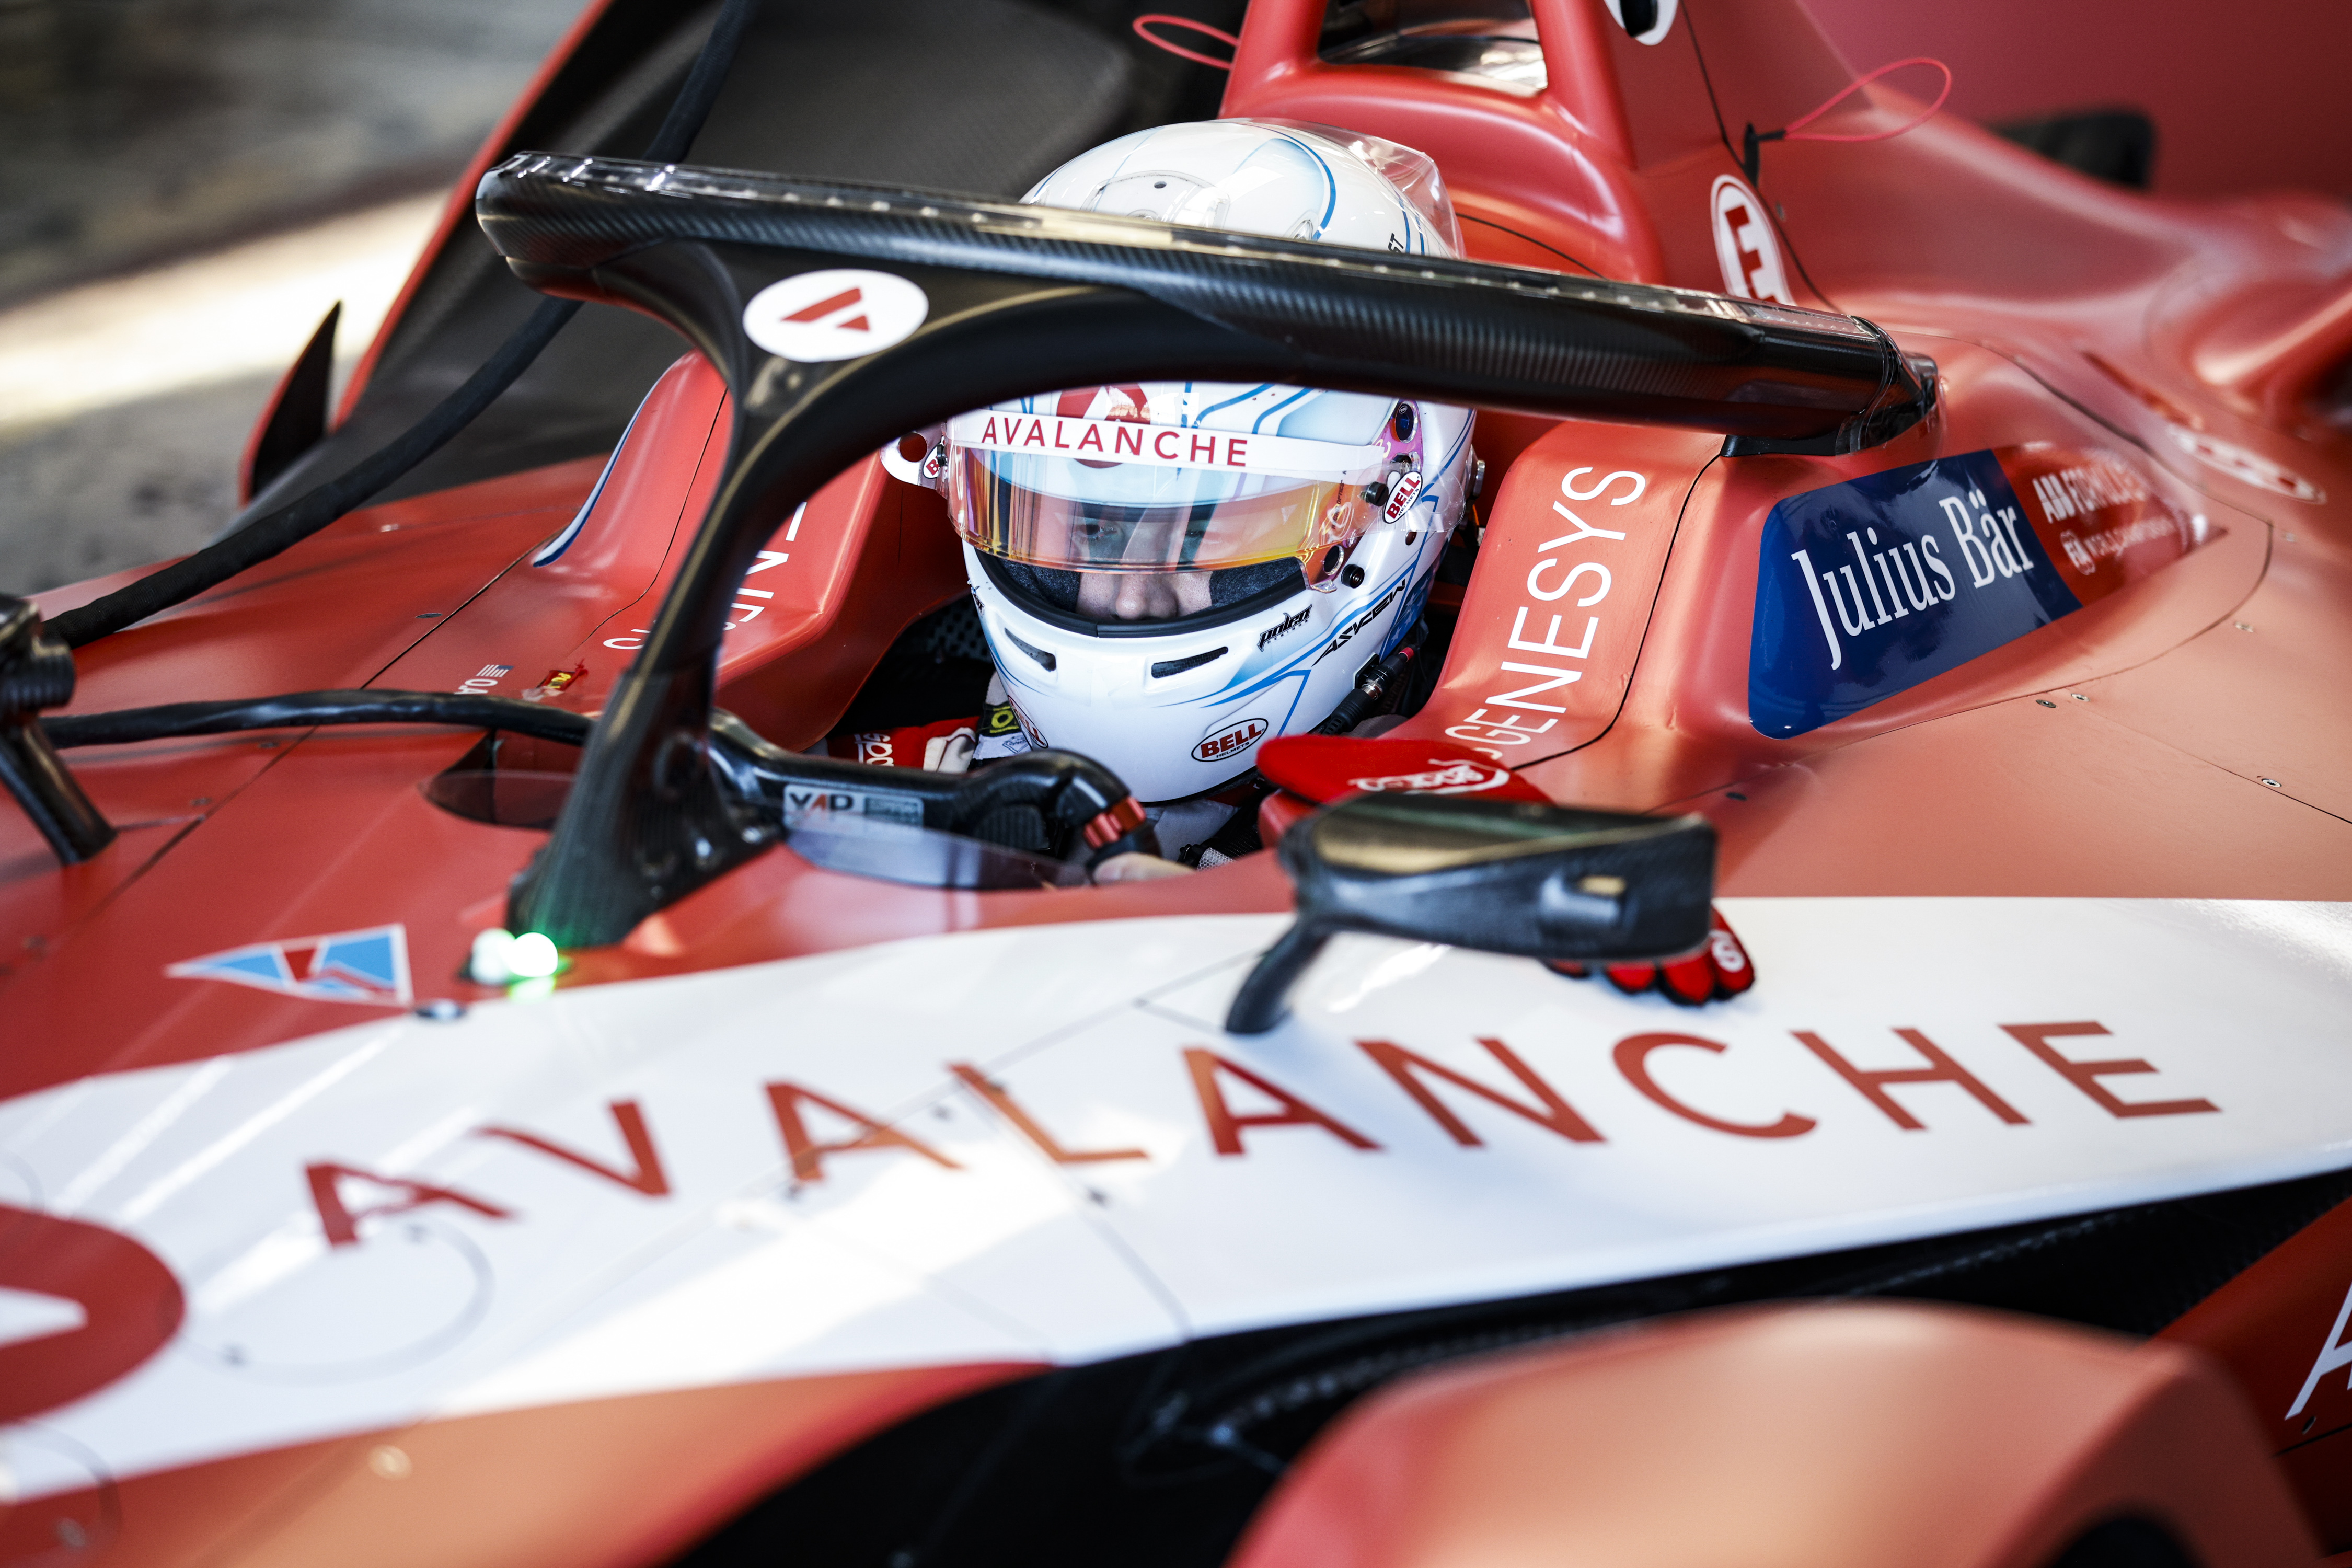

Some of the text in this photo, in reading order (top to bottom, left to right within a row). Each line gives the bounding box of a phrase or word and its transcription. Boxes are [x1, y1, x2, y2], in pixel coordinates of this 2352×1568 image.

[982, 417, 1249, 467] AVALANCHE
[1386, 477, 1421, 520] BELL
[1398, 488, 1419, 516] HELMETS
[1791, 490, 2034, 671] Julius Bär
[1445, 467, 1646, 746] GENESYS
[1201, 723, 1262, 758] BELL
[1216, 742, 1250, 758] HELMETS
[302, 1021, 2223, 1248] AVALANCHE
